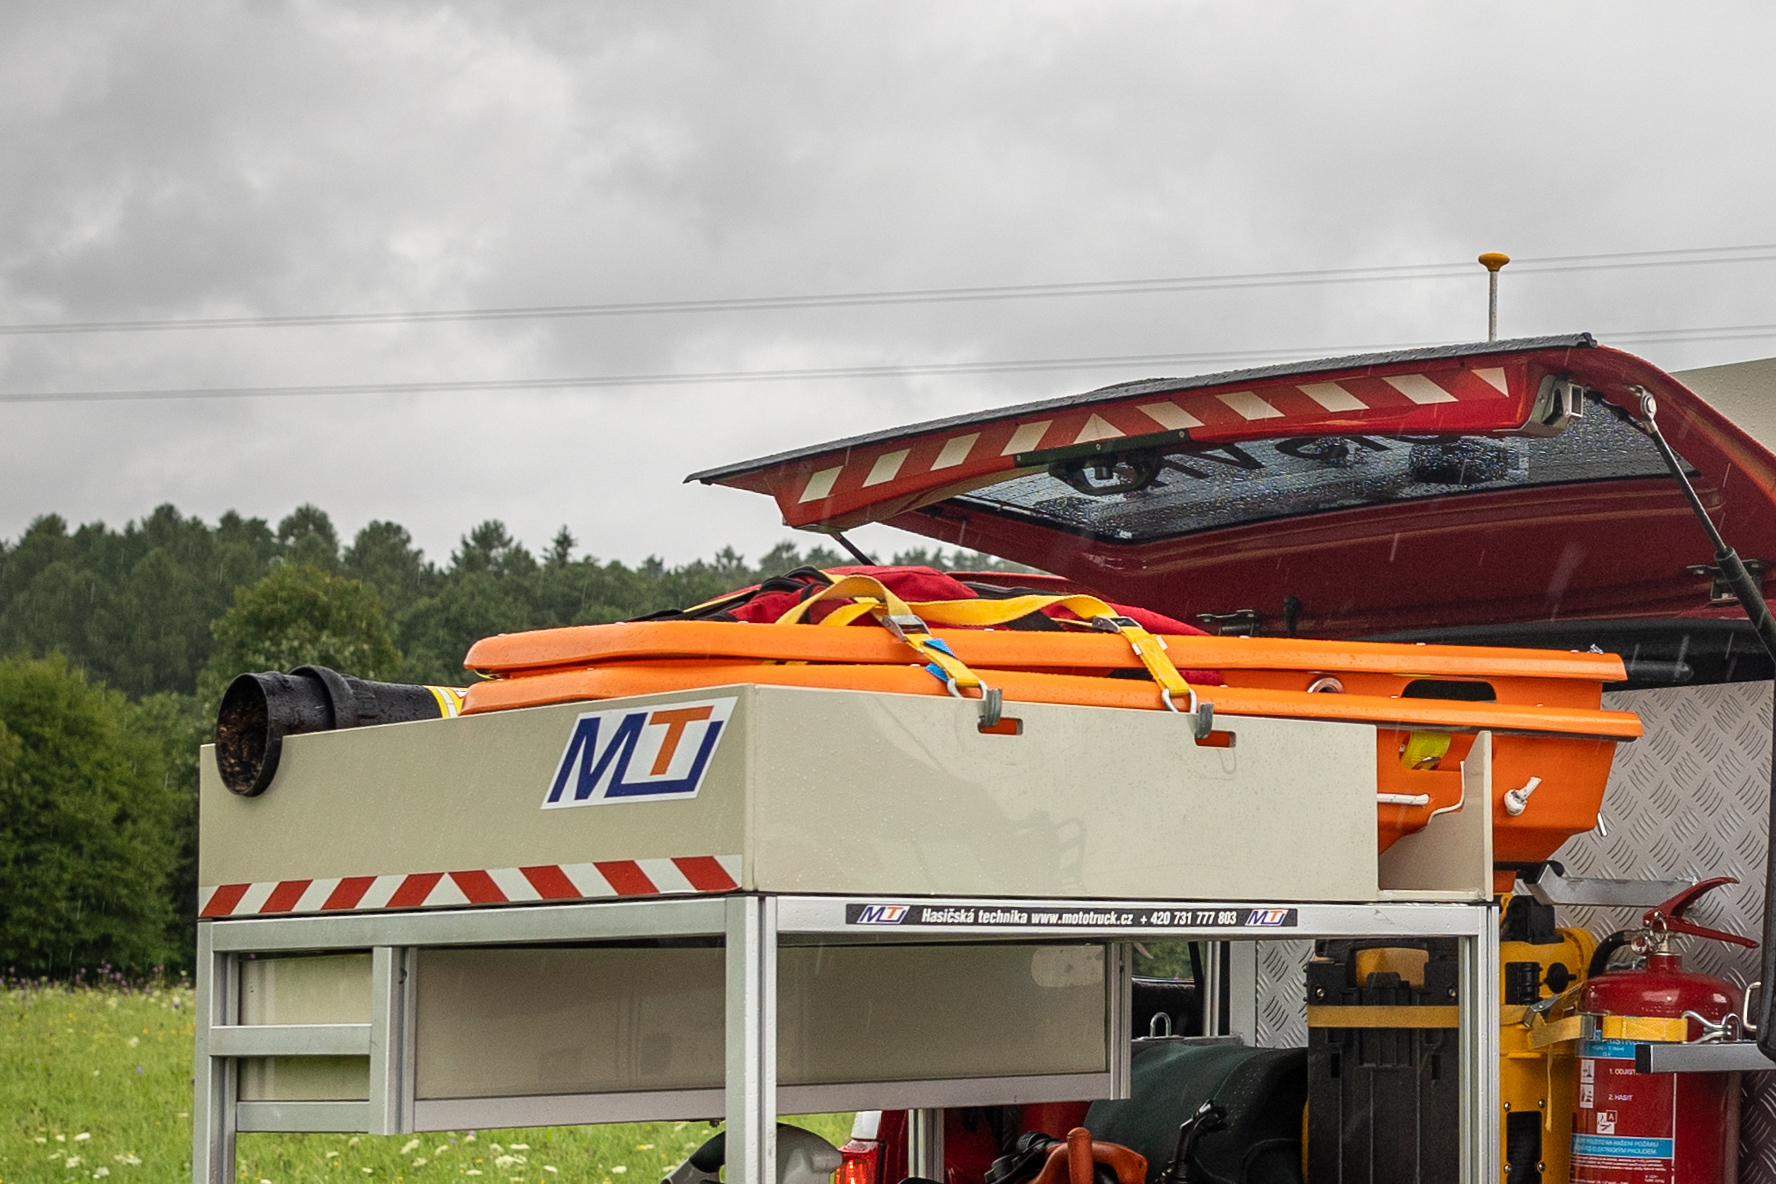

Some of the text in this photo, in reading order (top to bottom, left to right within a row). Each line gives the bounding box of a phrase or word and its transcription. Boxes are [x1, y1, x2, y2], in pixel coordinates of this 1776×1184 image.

[922, 908, 975, 923] Hasičská
[978, 910, 1028, 924] technika
[1032, 910, 1133, 925] www.mototruck.cz
[1151, 911, 1170, 925] 420
[1174, 911, 1192, 925] 731
[1196, 911, 1214, 925] 777
[1218, 911, 1237, 925] 803
